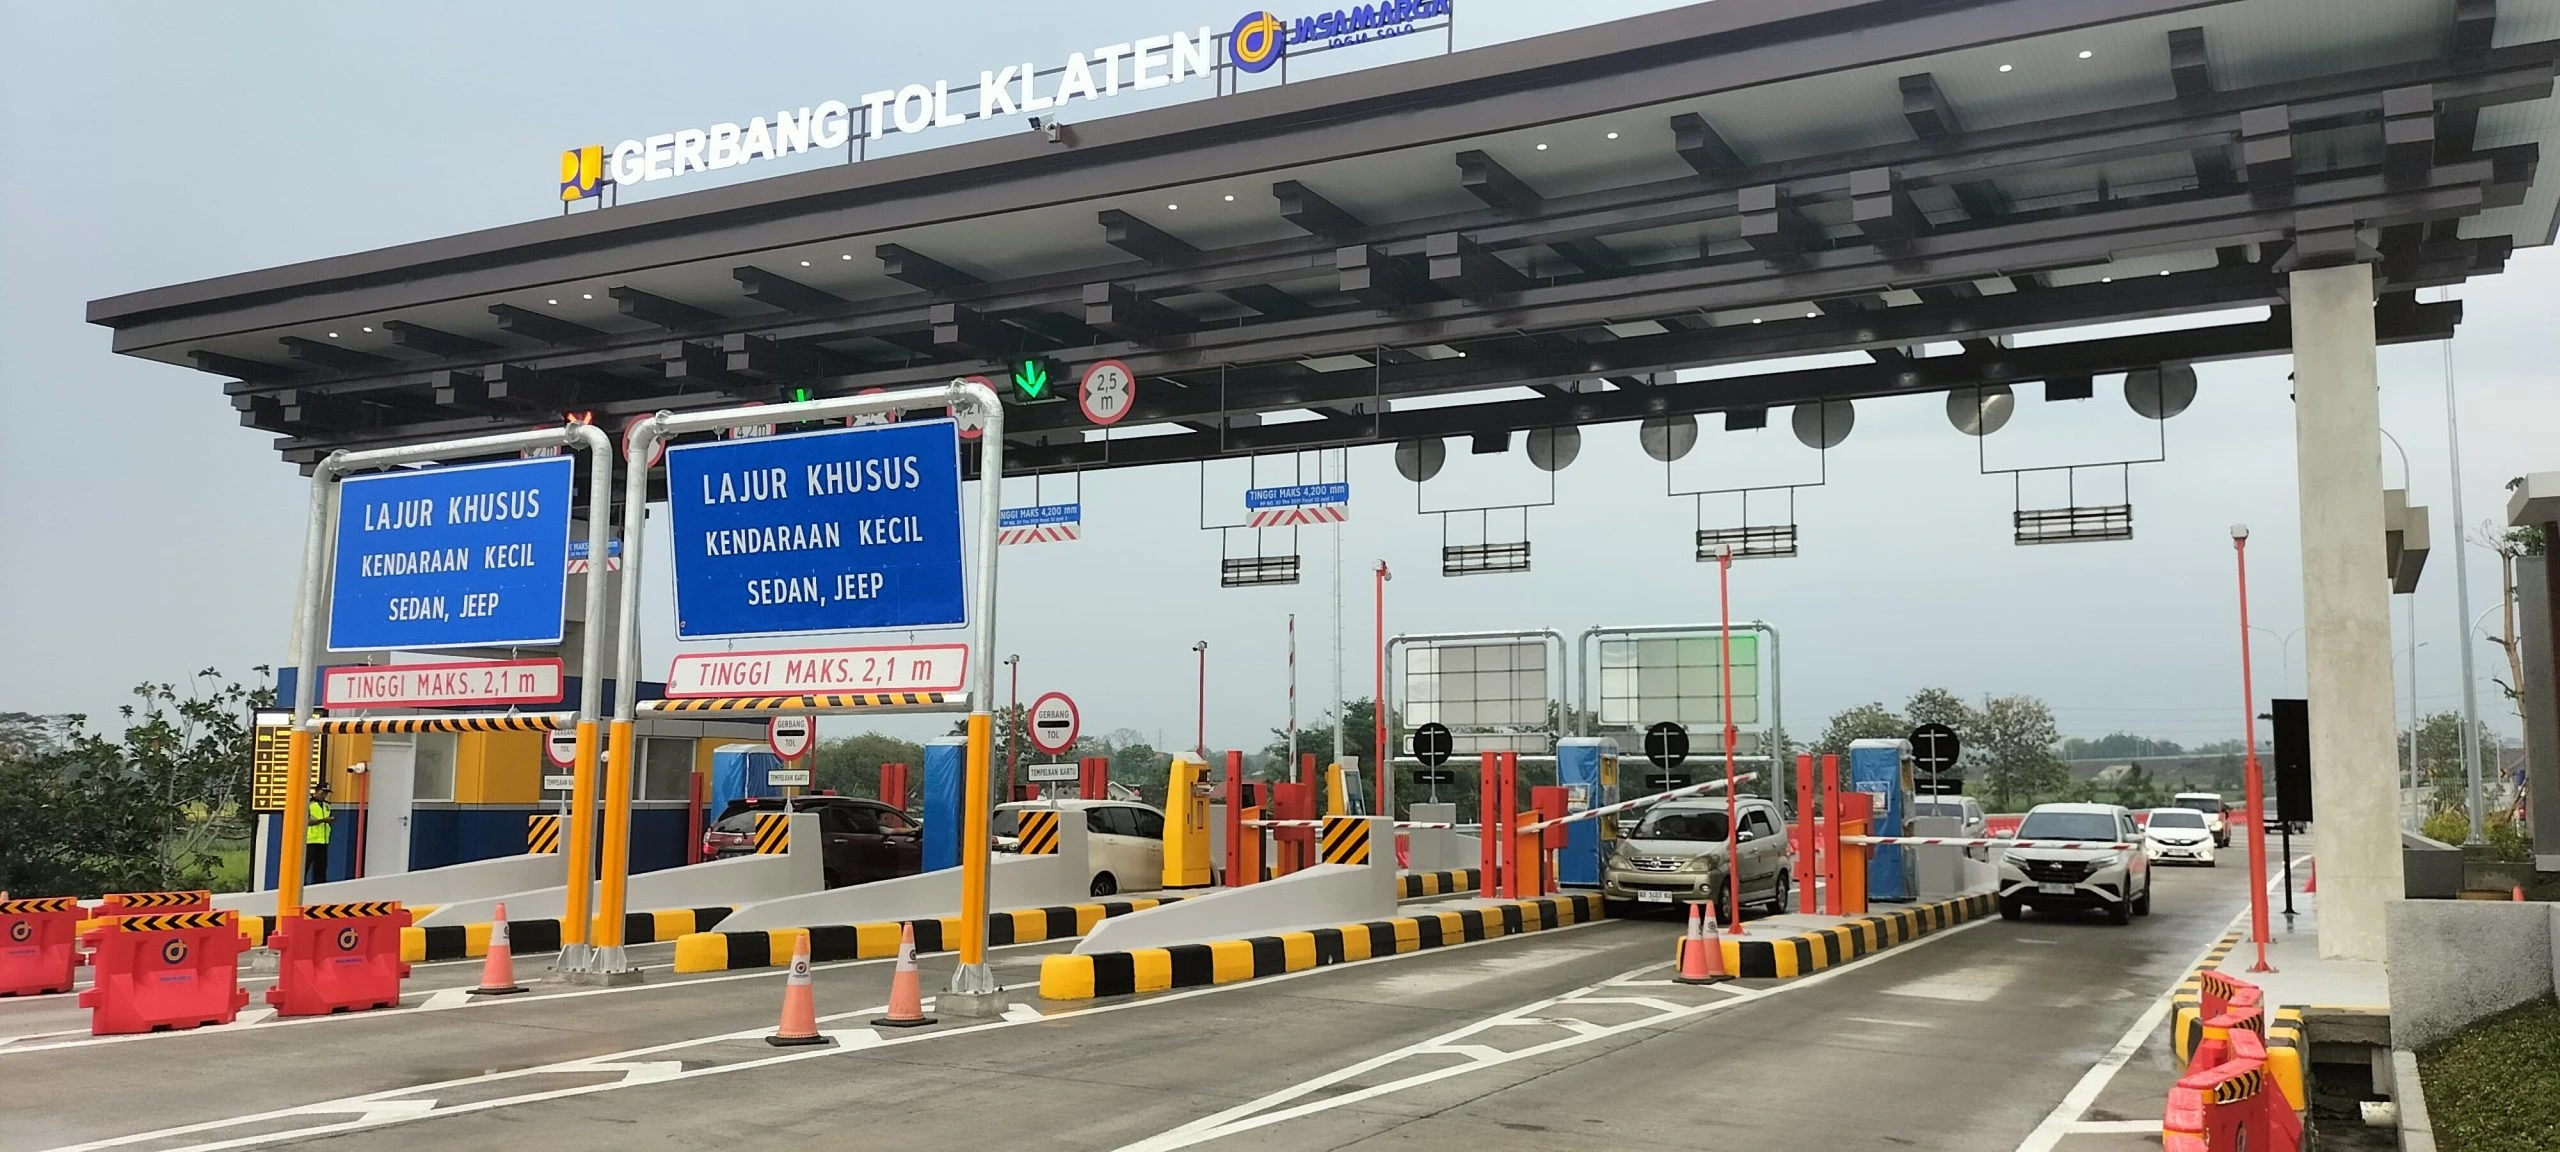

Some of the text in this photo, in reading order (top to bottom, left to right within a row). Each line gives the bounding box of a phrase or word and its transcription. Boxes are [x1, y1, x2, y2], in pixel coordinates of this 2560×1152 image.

[1377, 23, 1415, 40] SOLO
[611, 25, 1211, 185] GERBANG TOL KLATEN
[1097, 372, 1117, 393] 2,5
[1101, 395, 1113, 410] m
[703, 455, 920, 505] LAJUR KHUSUS
[1250, 485, 1345, 500] TINGGI MAKS 4,200 mm
[364, 488, 541, 532] LAJUR KHUSUS
[1000, 510, 1018, 520] NGGI
[1020, 508, 1039, 518] MAKS
[1041, 506, 1062, 517] 4,200
[705, 515, 924, 557] KENDARAAN KECIL
[361, 543, 535, 578] KENDARAAN KECIL
[747, 572, 884, 607] SEDAN, JEEP
[388, 592, 500, 623] SEDAN, JEEP
[699, 656, 932, 686] TINGGI MAKS. 2,1 m
[347, 670, 536, 698] TINGGI MAKS. 2,1 m
[777, 719, 805, 728] GERBANG
[1038, 710, 1070, 719] GERBANG
[785, 738, 796, 747] TOL
[1047, 730, 1059, 739] TOL
[1031, 767, 1077, 777] TEMPELKAN KARTU
